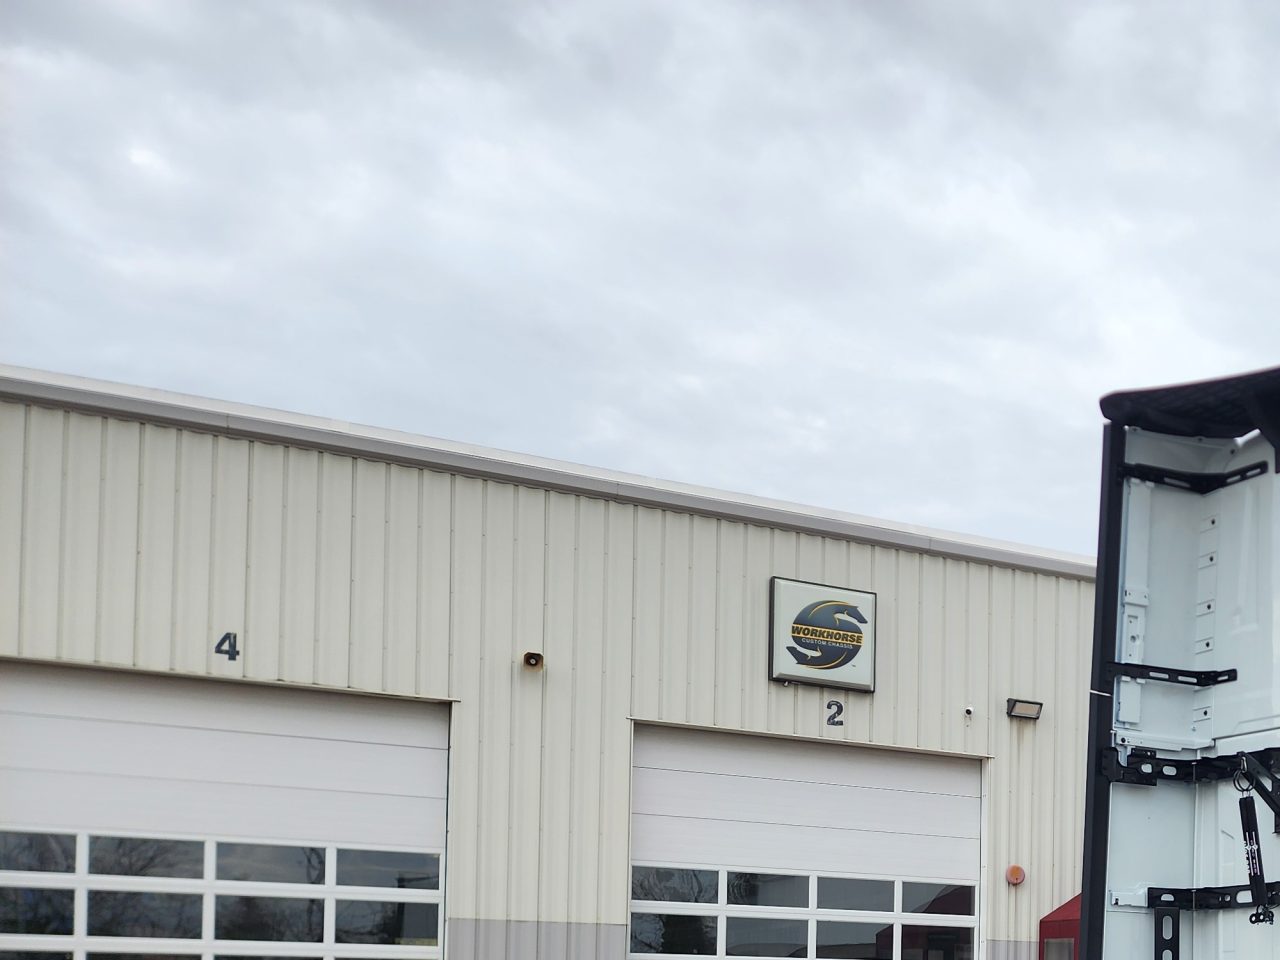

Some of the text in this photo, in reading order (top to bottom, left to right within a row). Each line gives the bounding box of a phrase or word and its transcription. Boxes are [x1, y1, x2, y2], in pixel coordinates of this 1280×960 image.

[214, 632, 240, 661] 4
[791, 625, 863, 645] WORKHORSE
[802, 637, 827, 646] CUSTOM
[826, 700, 844, 726] 2
